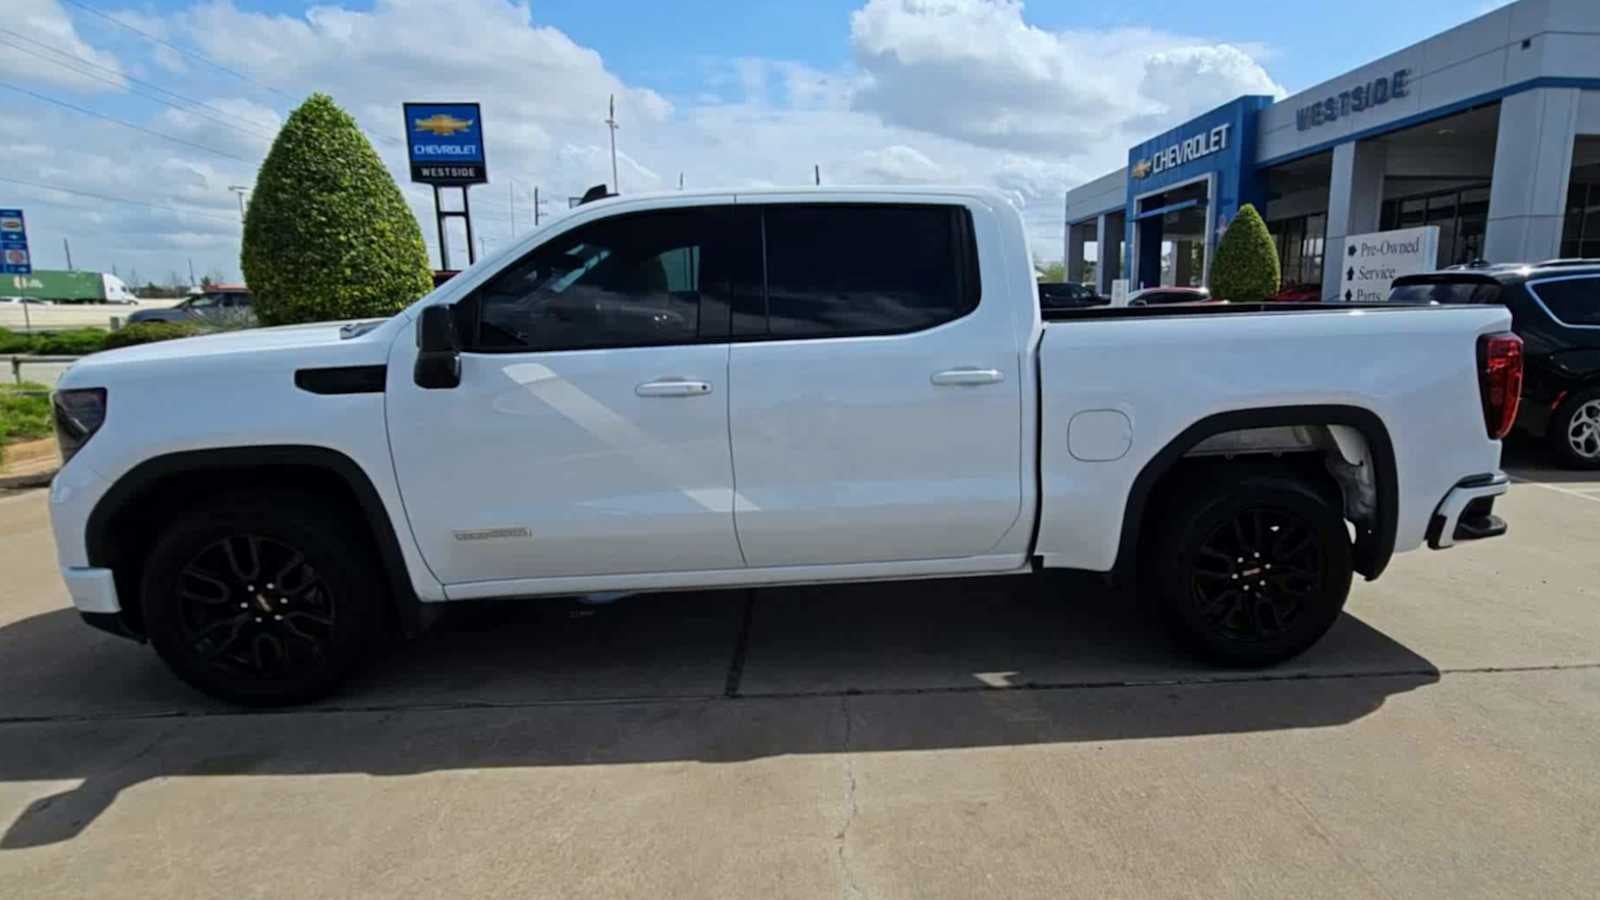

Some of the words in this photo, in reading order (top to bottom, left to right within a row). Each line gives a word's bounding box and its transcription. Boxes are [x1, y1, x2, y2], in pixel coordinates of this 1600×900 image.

[1296, 68, 1412, 132] WESTSIDE
[413, 144, 477, 155] CHEVROLET
[1152, 122, 1231, 174] CHEVROLET
[420, 167, 476, 177] WESTSIDE
[1360, 236, 1420, 257] Pre-Owned
[1359, 264, 1396, 281] Service
